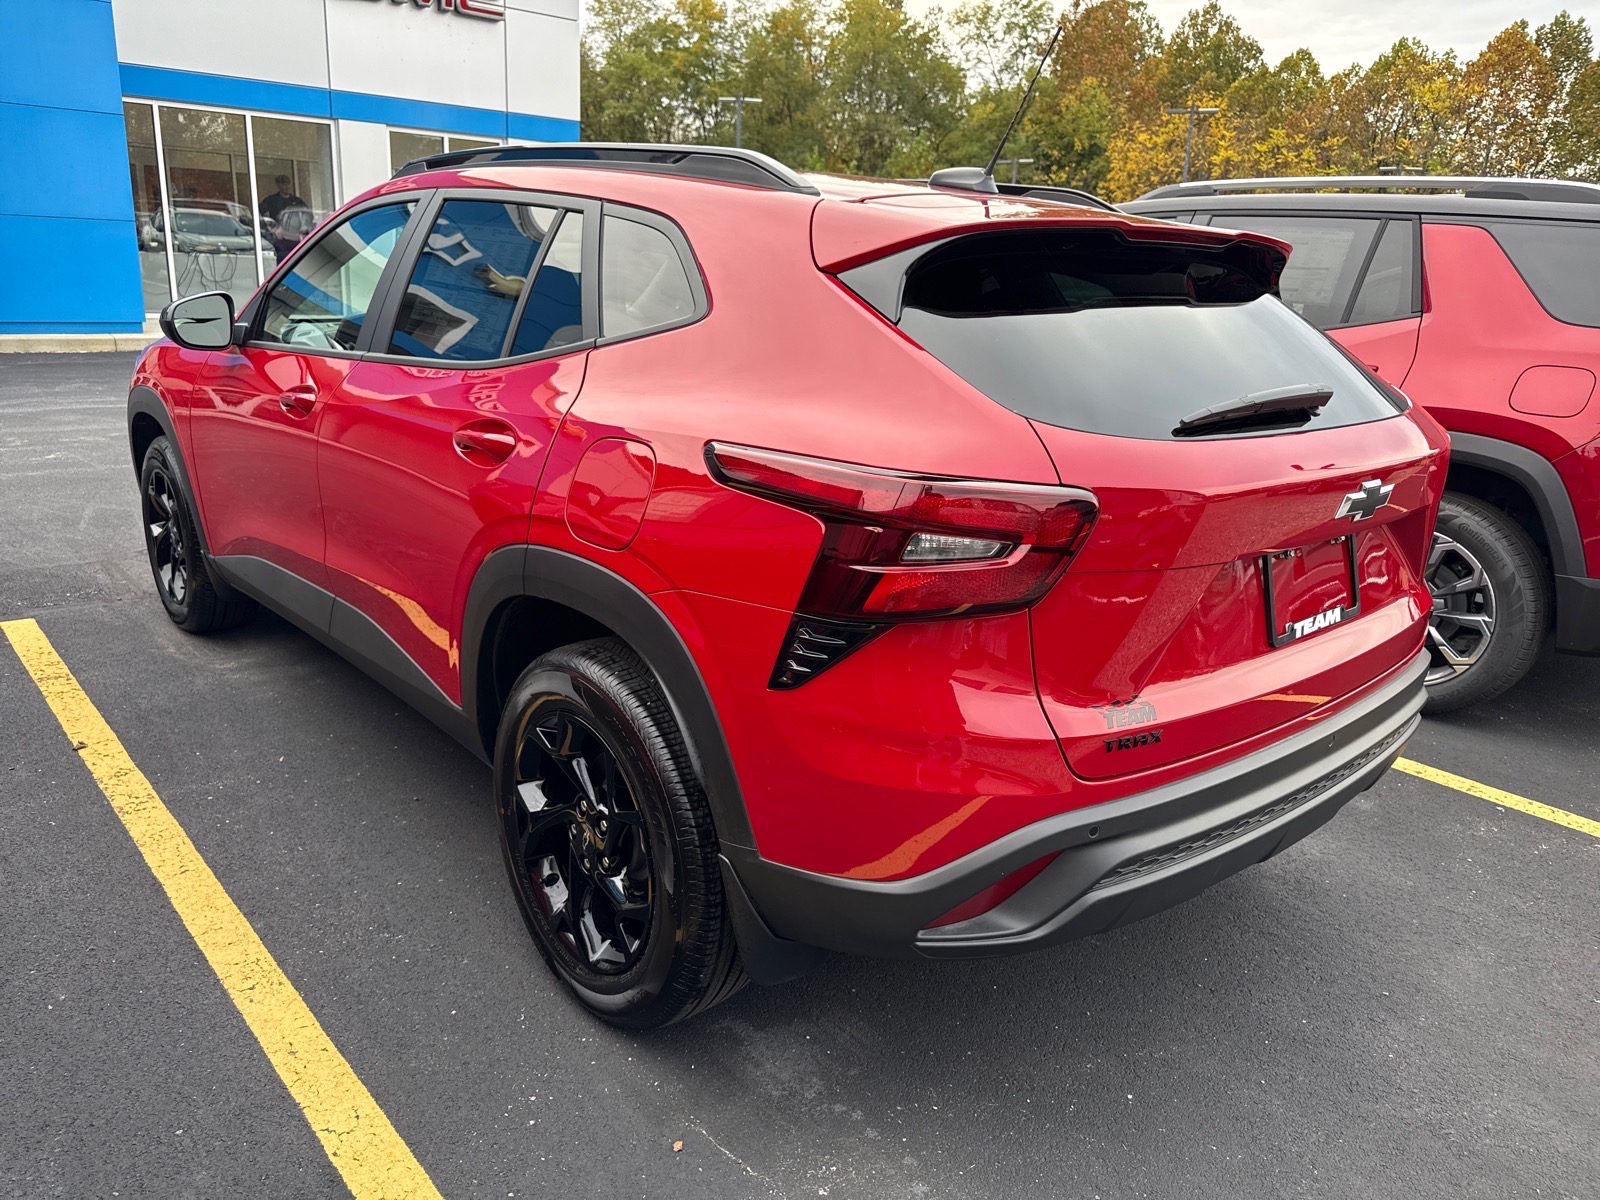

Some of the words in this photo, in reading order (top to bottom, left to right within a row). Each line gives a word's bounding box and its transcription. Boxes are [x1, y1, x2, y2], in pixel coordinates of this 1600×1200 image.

[1459, 523, 1504, 565] Continental
[1294, 606, 1341, 638] TEAM
[1103, 705, 1158, 729] TEAM
[1103, 730, 1163, 753] TRAX
